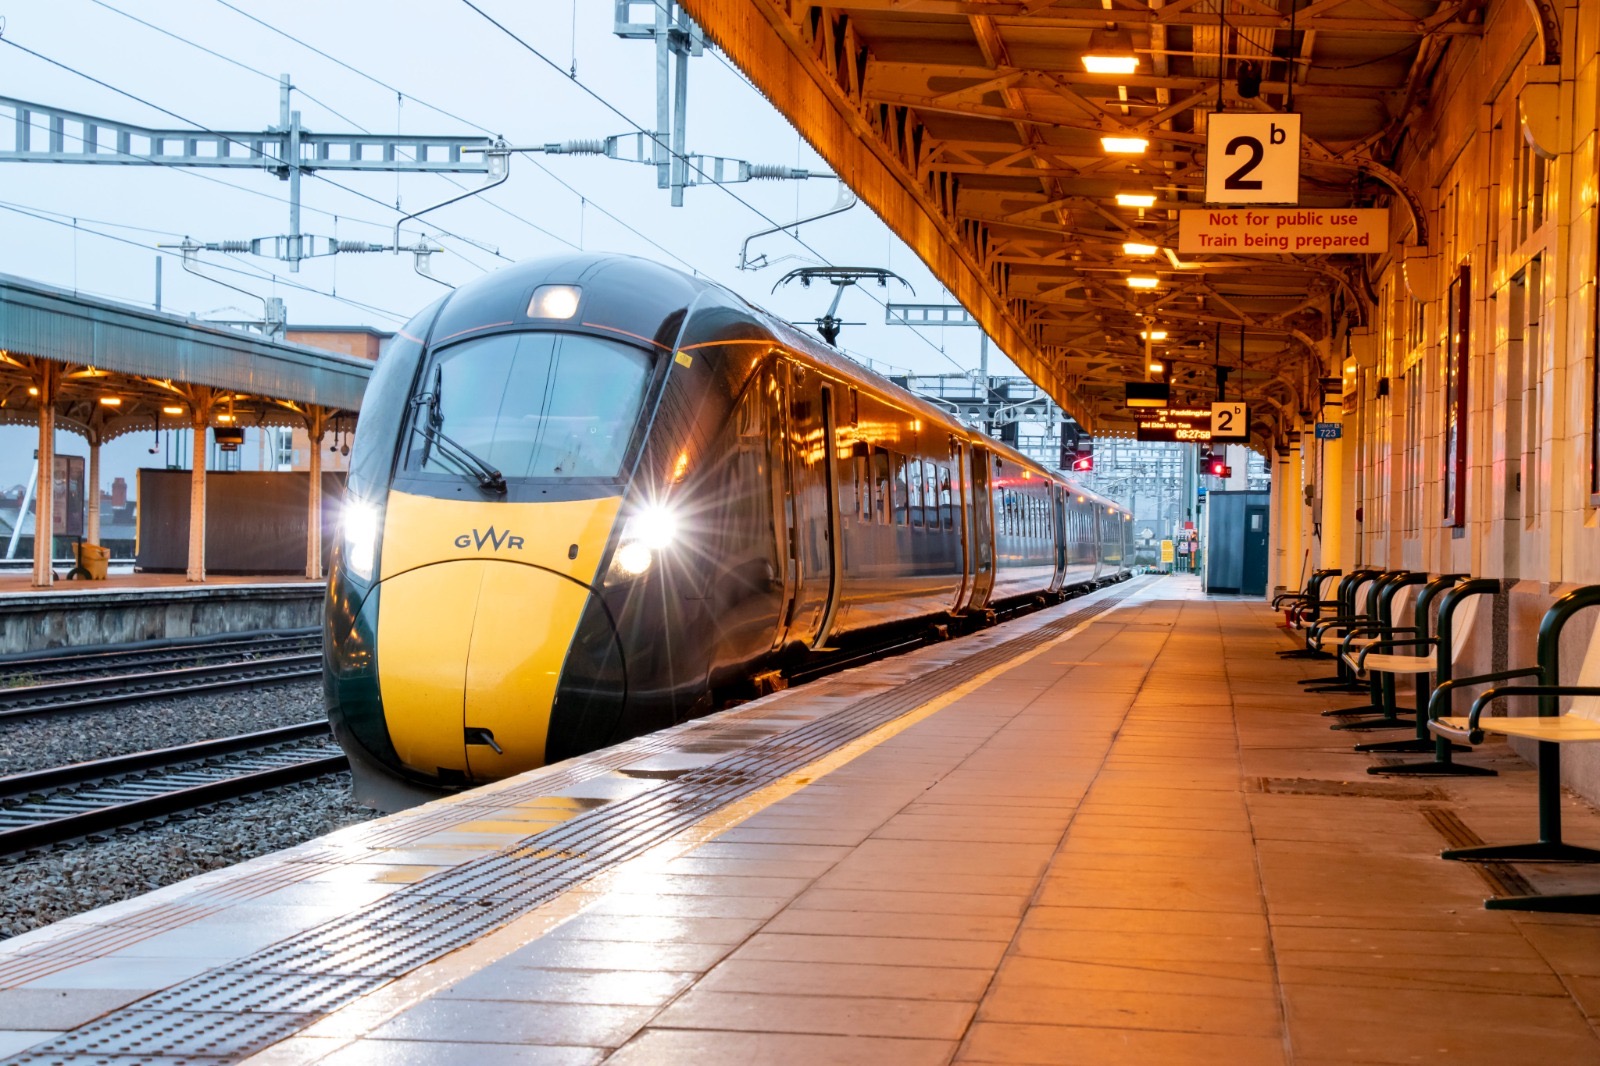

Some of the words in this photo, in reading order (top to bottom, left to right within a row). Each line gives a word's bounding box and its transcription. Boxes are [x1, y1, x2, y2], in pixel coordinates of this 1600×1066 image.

[1209, 213, 1238, 226] Not
[1246, 212, 1269, 226] for
[1276, 212, 1324, 228] public
[1330, 215, 1358, 226] use
[1198, 233, 1238, 247] Train
[1244, 233, 1289, 249] being
[1295, 232, 1370, 249] prepared
[1320, 429, 1336, 437] 723
[454, 525, 525, 552] GWR
